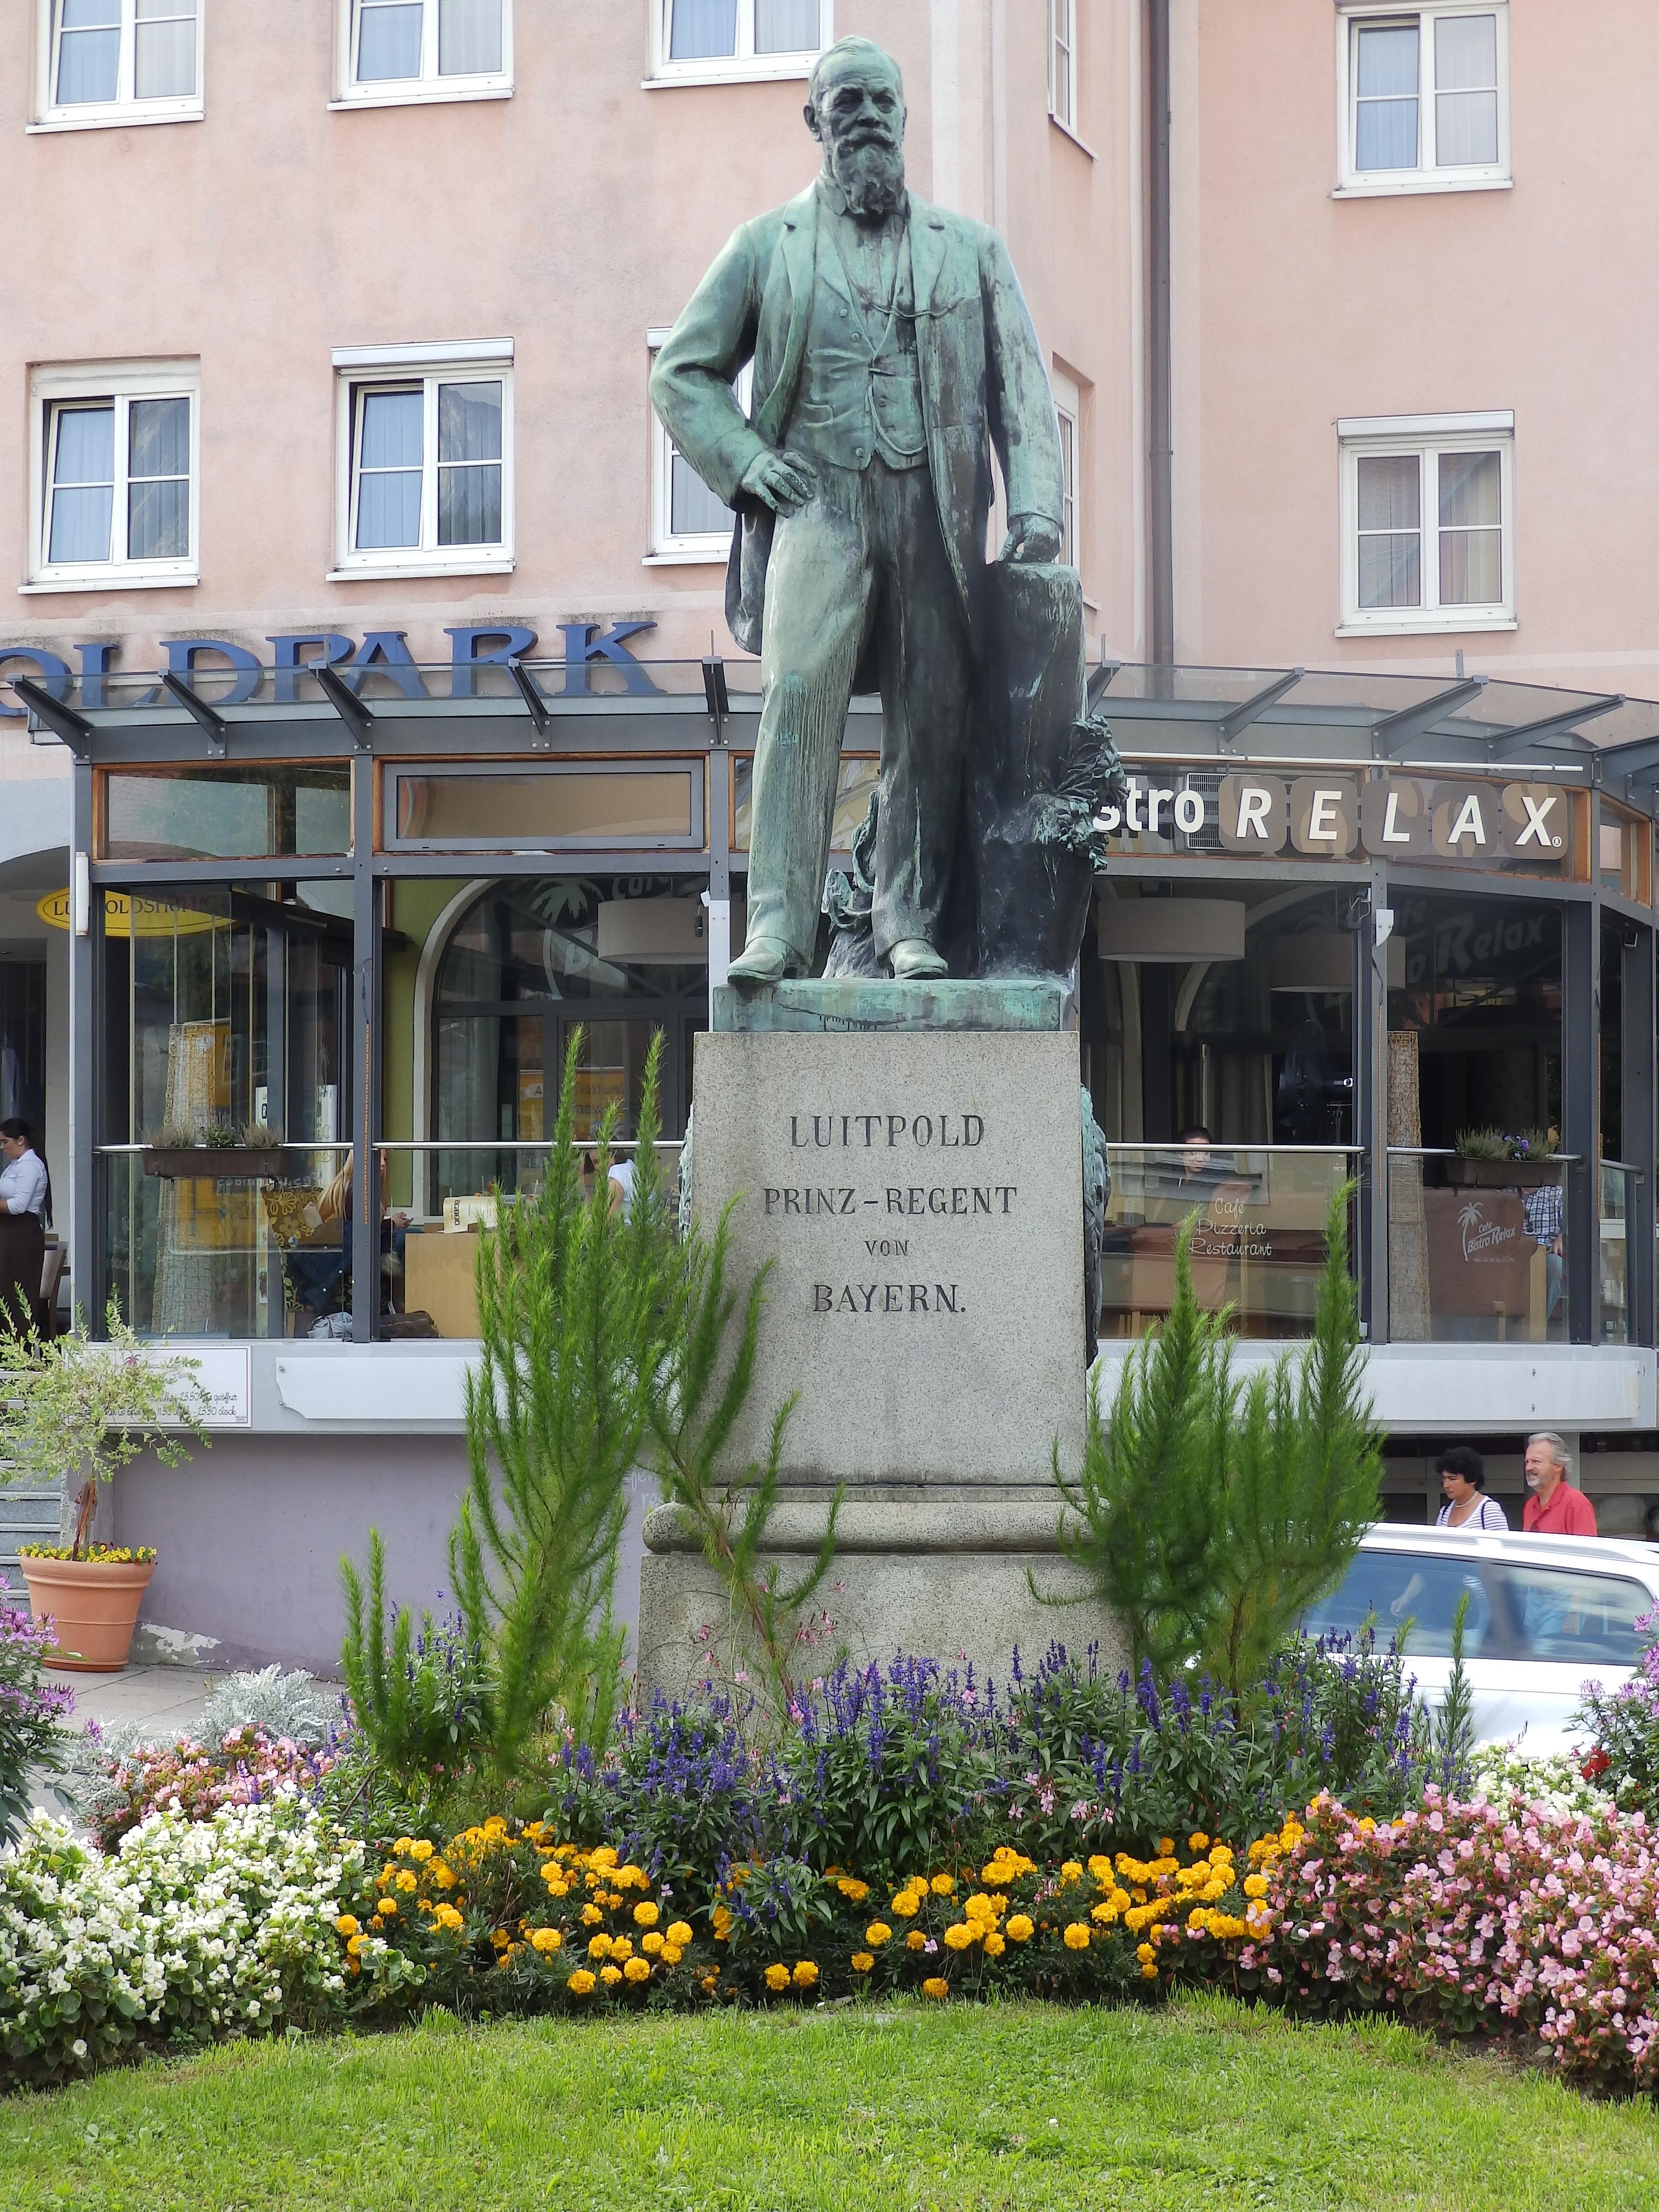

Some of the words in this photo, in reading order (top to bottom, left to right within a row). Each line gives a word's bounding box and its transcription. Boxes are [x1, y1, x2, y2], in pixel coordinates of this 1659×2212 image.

[1093, 777, 1204, 833] stro
[789, 1115, 985, 1148] LUITPOLD
[1214, 1197, 1245, 1219] Café
[1196, 1218, 1267, 1235] Pizzeria
[865, 1241, 909, 1257] VON
[1188, 1238, 1272, 1256] Restaurant
[1467, 1237, 1490, 1253] Bistro
[1490, 1226, 1516, 1244] Relax
[812, 1284, 966, 1313] BAYERN.
